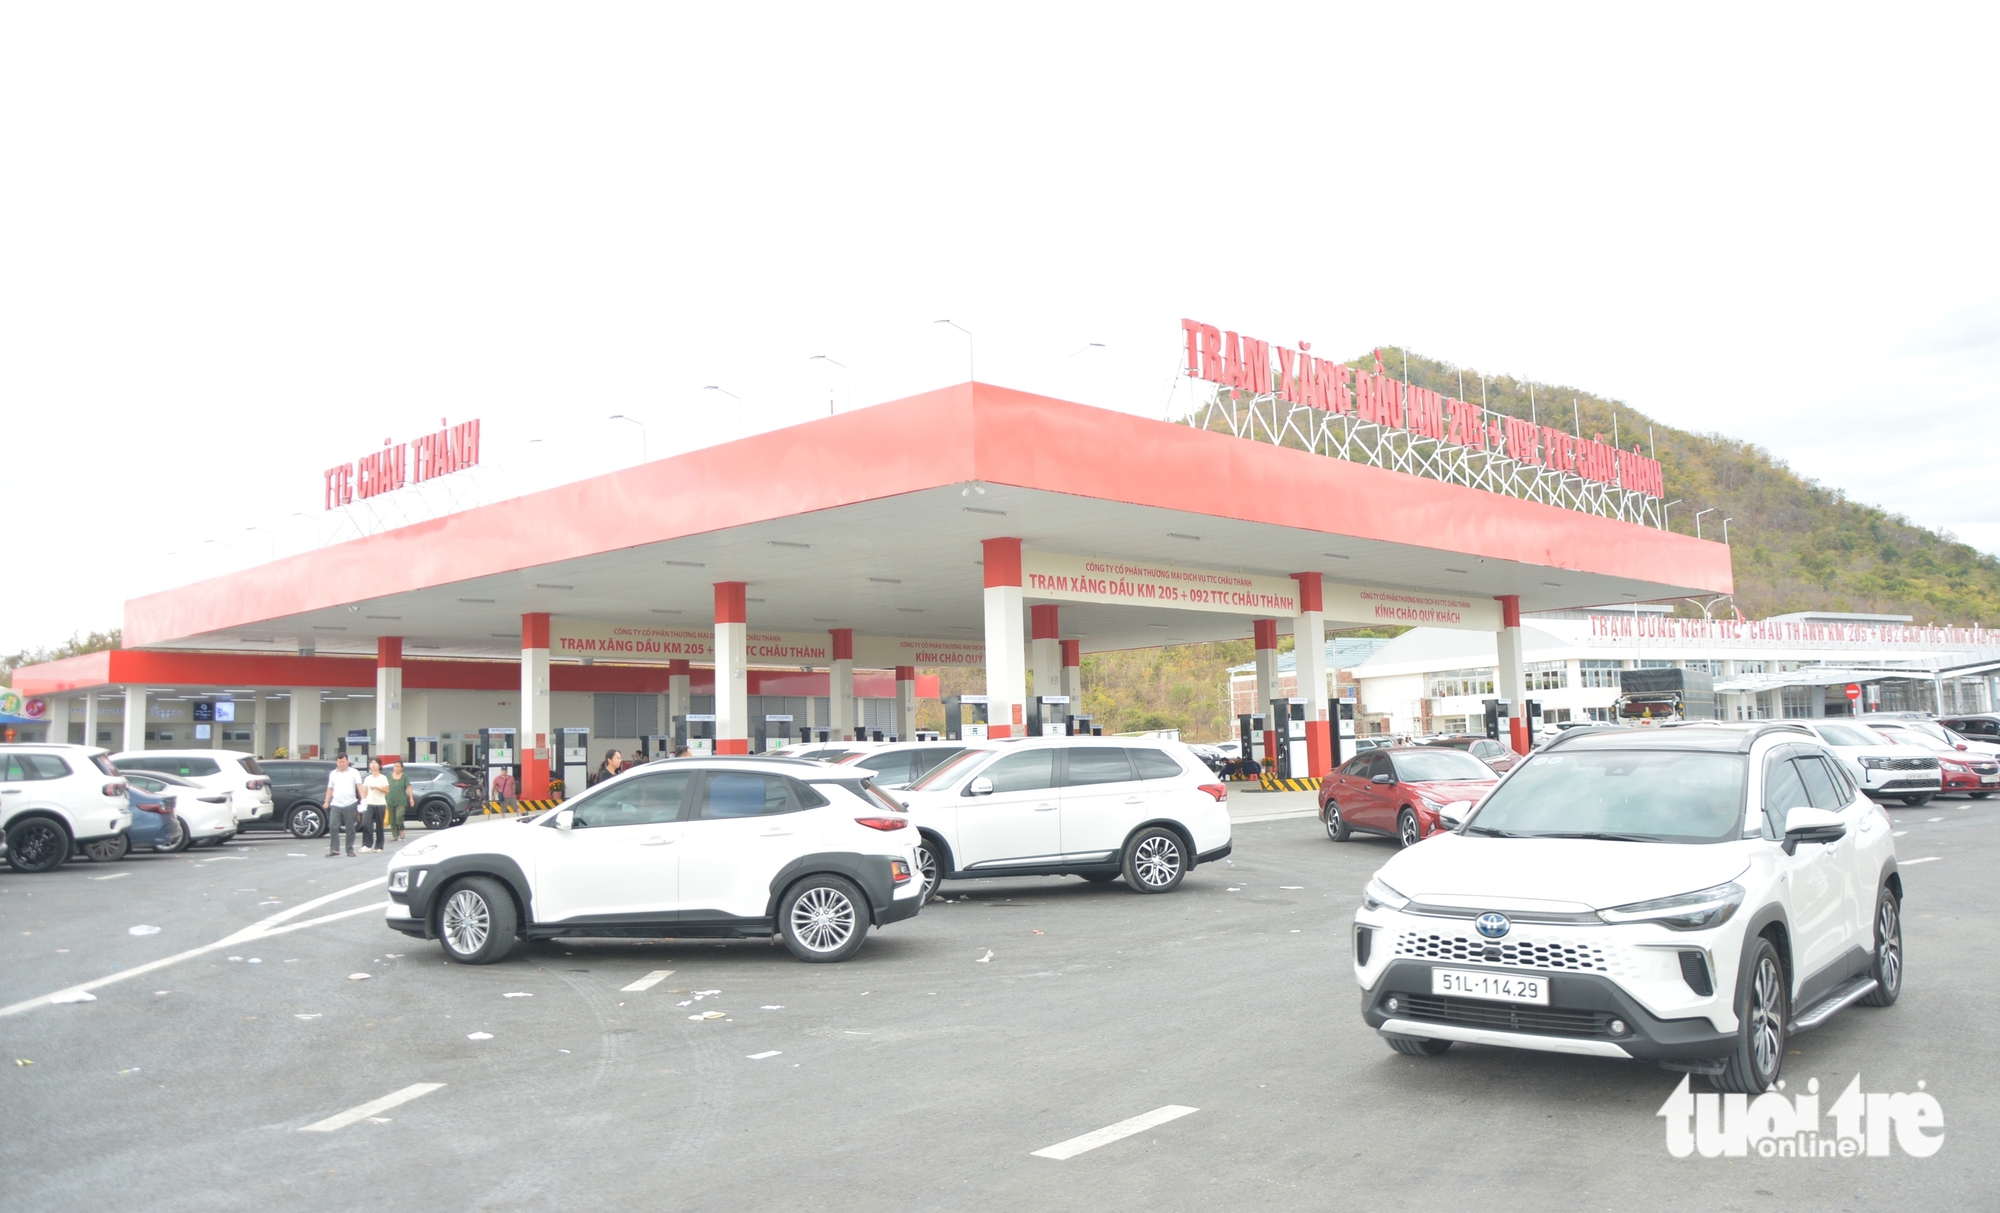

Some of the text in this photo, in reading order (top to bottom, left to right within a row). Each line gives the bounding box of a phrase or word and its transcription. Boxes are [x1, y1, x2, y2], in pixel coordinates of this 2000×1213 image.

[1181, 318, 1664, 499] TRẠM XĂNG DẦU KM 205 + 092 TTC CHÂU THÀNH
[324, 417, 480, 511] TTC CHÂU THÀNH
[1086, 562, 1104, 573] CÔNG
[1105, 564, 1114, 573] TY
[1144, 568, 1170, 580] THƯƠNG
[1171, 572, 1182, 582] MẠI
[1183, 573, 1197, 583] DỊCH
[1198, 575, 1206, 585] VỤ
[1207, 575, 1217, 584] TTC
[1218, 576, 1233, 586] CHÂU
[1233, 578, 1253, 588] THÀNH
[1029, 573, 1294, 611] TRẠM XĂNG DẦU KM 205 + 092 TTC CHÂU THÀNH
[1373, 592, 1379, 600] TY
[1375, 604, 1461, 624] KÍNH CHÀO QUÝ KHÁCH
[614, 627, 632, 636] CÔNG
[633, 628, 641, 636] TY
[670, 630, 697, 639] THƯƠNG
[697, 632, 709, 641] MẠI
[762, 634, 781, 642] THÀNH
[1590, 615, 1632, 642] TRẠM
[1718, 619, 1742, 639] TTC
[1827, 622, 1845, 641] KM
[1848, 623, 1867, 642] 205
[1871, 628, 1876, 638] +
[1881, 624, 1899, 642] 092
[560, 637, 825, 659] TRẠM XĂNG DẦU KM 205 + TC CHÂU THÀNH
[915, 650, 984, 664] KÍNH CHÀO QUÝ
[1443, 974, 1538, 998] 51L-114.29
